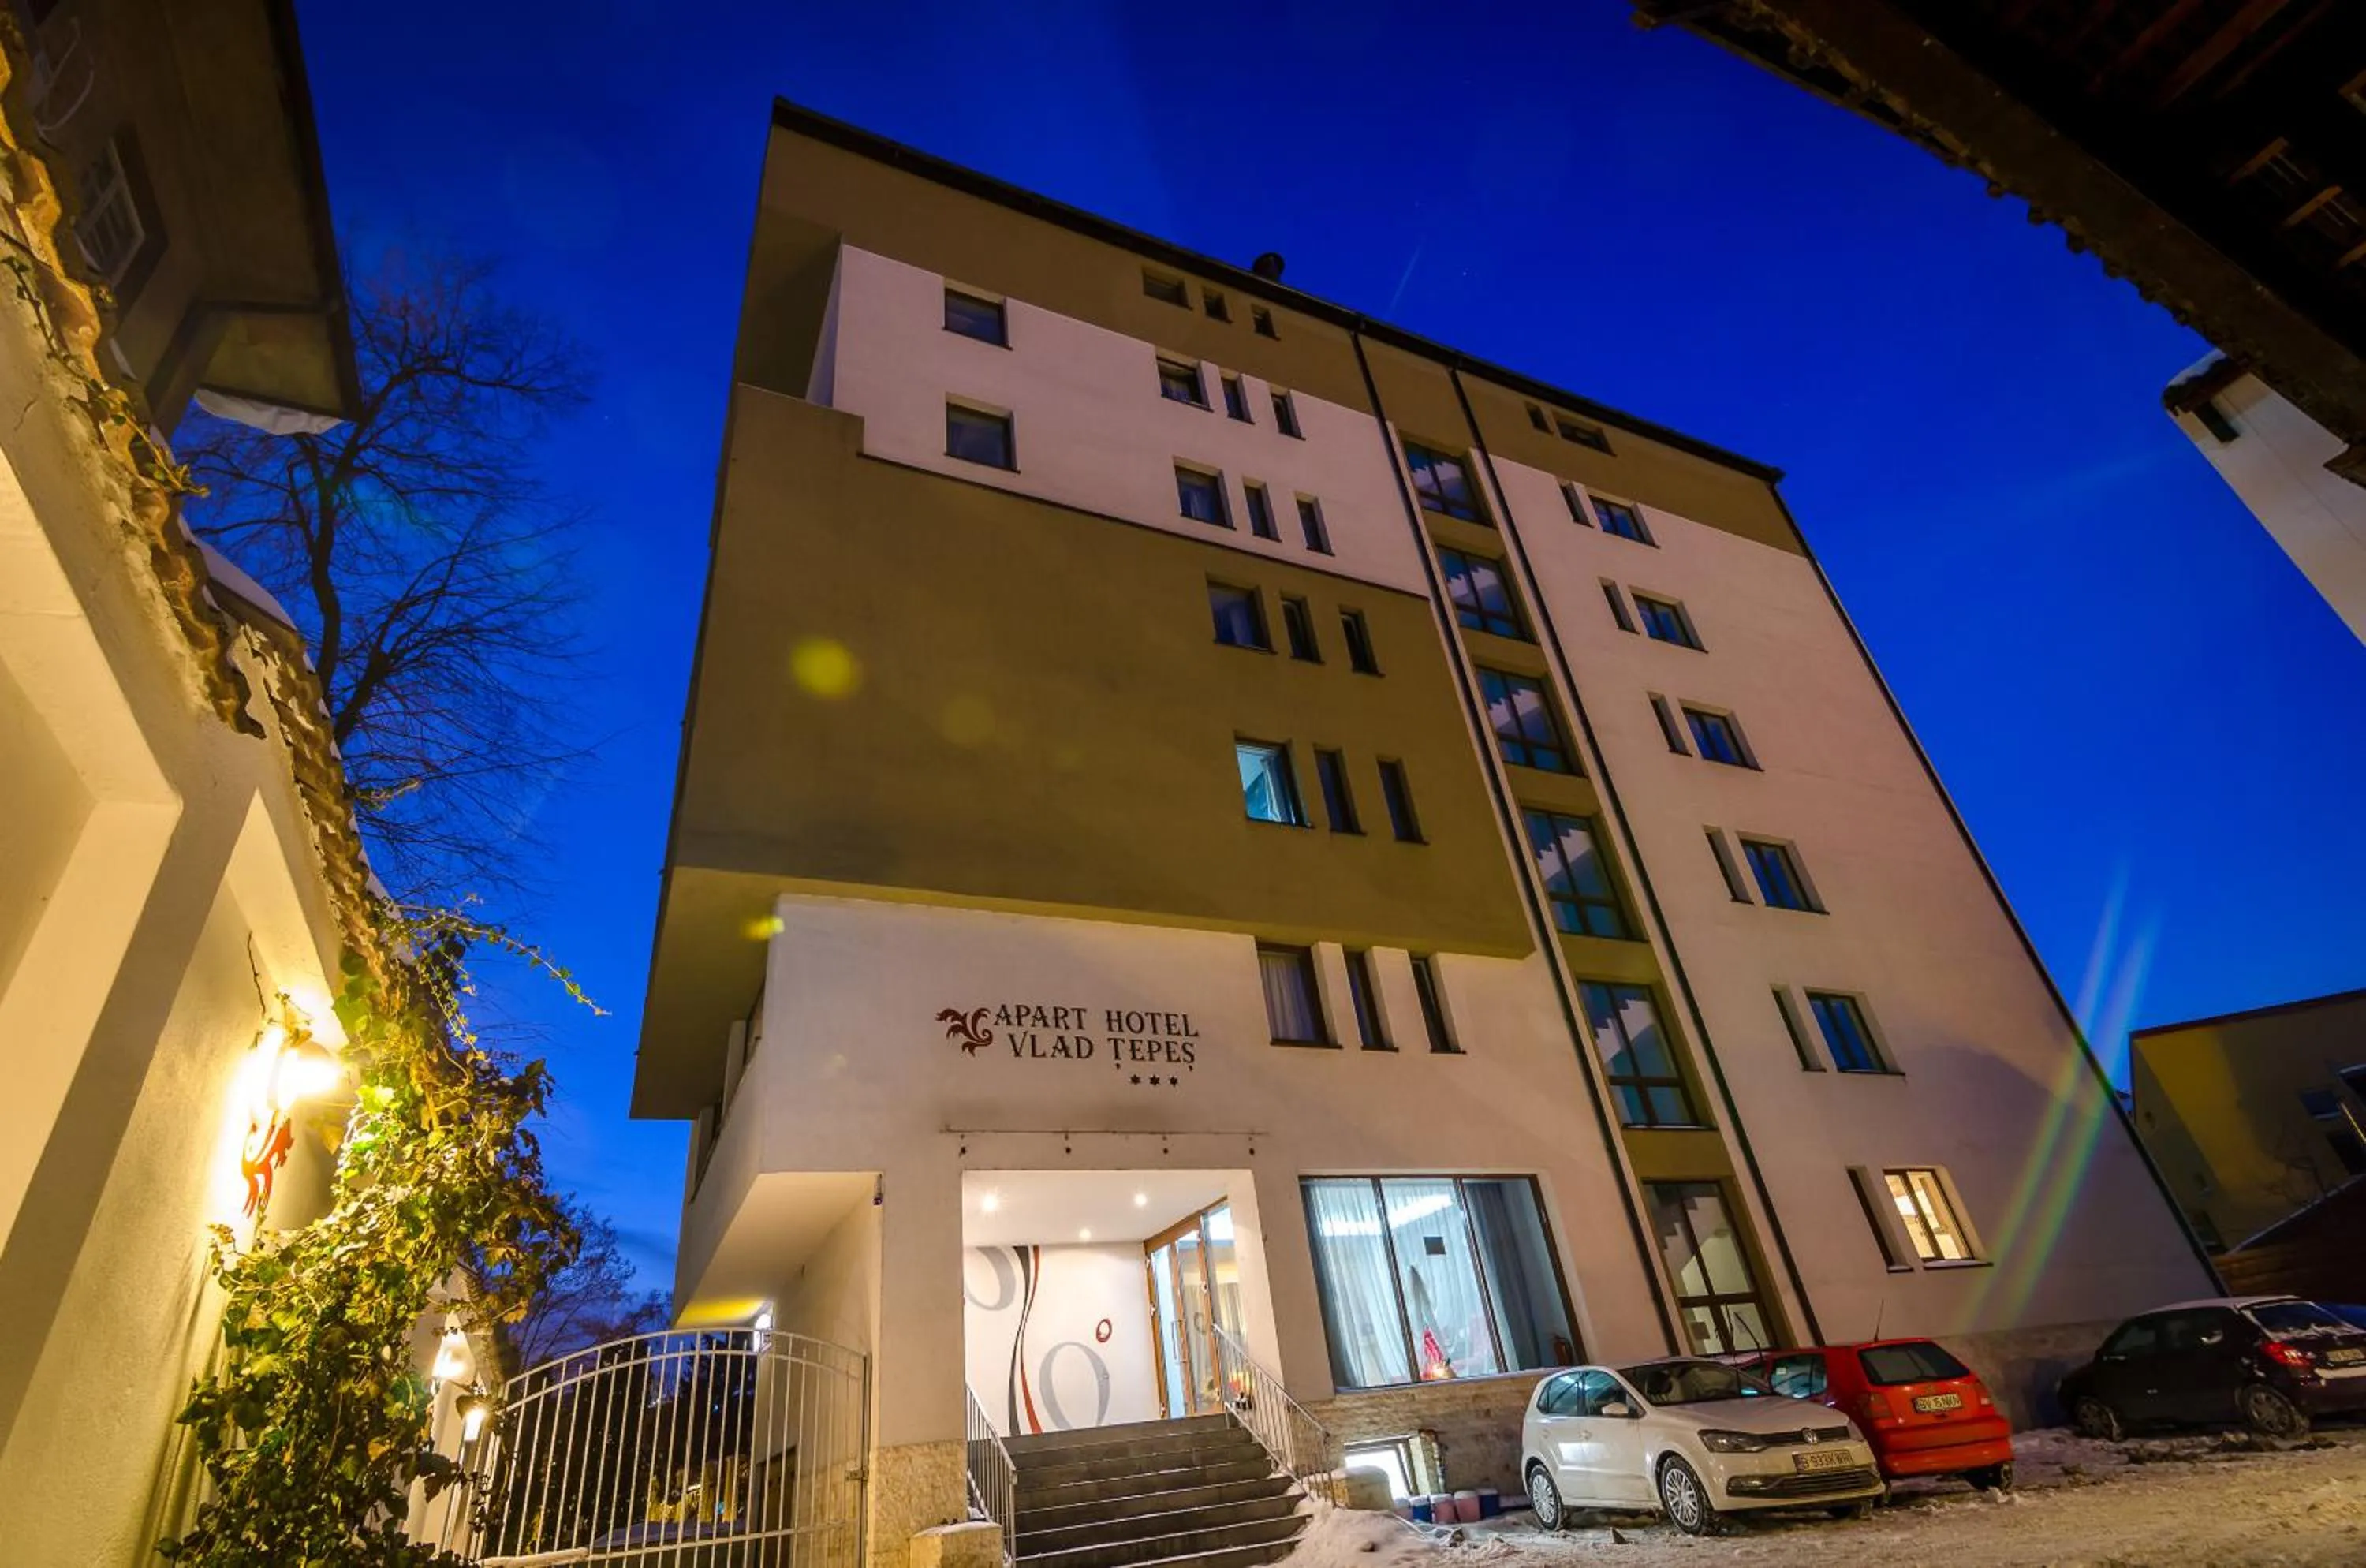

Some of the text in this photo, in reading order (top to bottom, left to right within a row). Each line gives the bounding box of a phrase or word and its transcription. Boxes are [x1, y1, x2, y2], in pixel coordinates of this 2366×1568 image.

[994, 1004, 1199, 1037] APART HOTEL
[1009, 1031, 1094, 1059] VLAD
